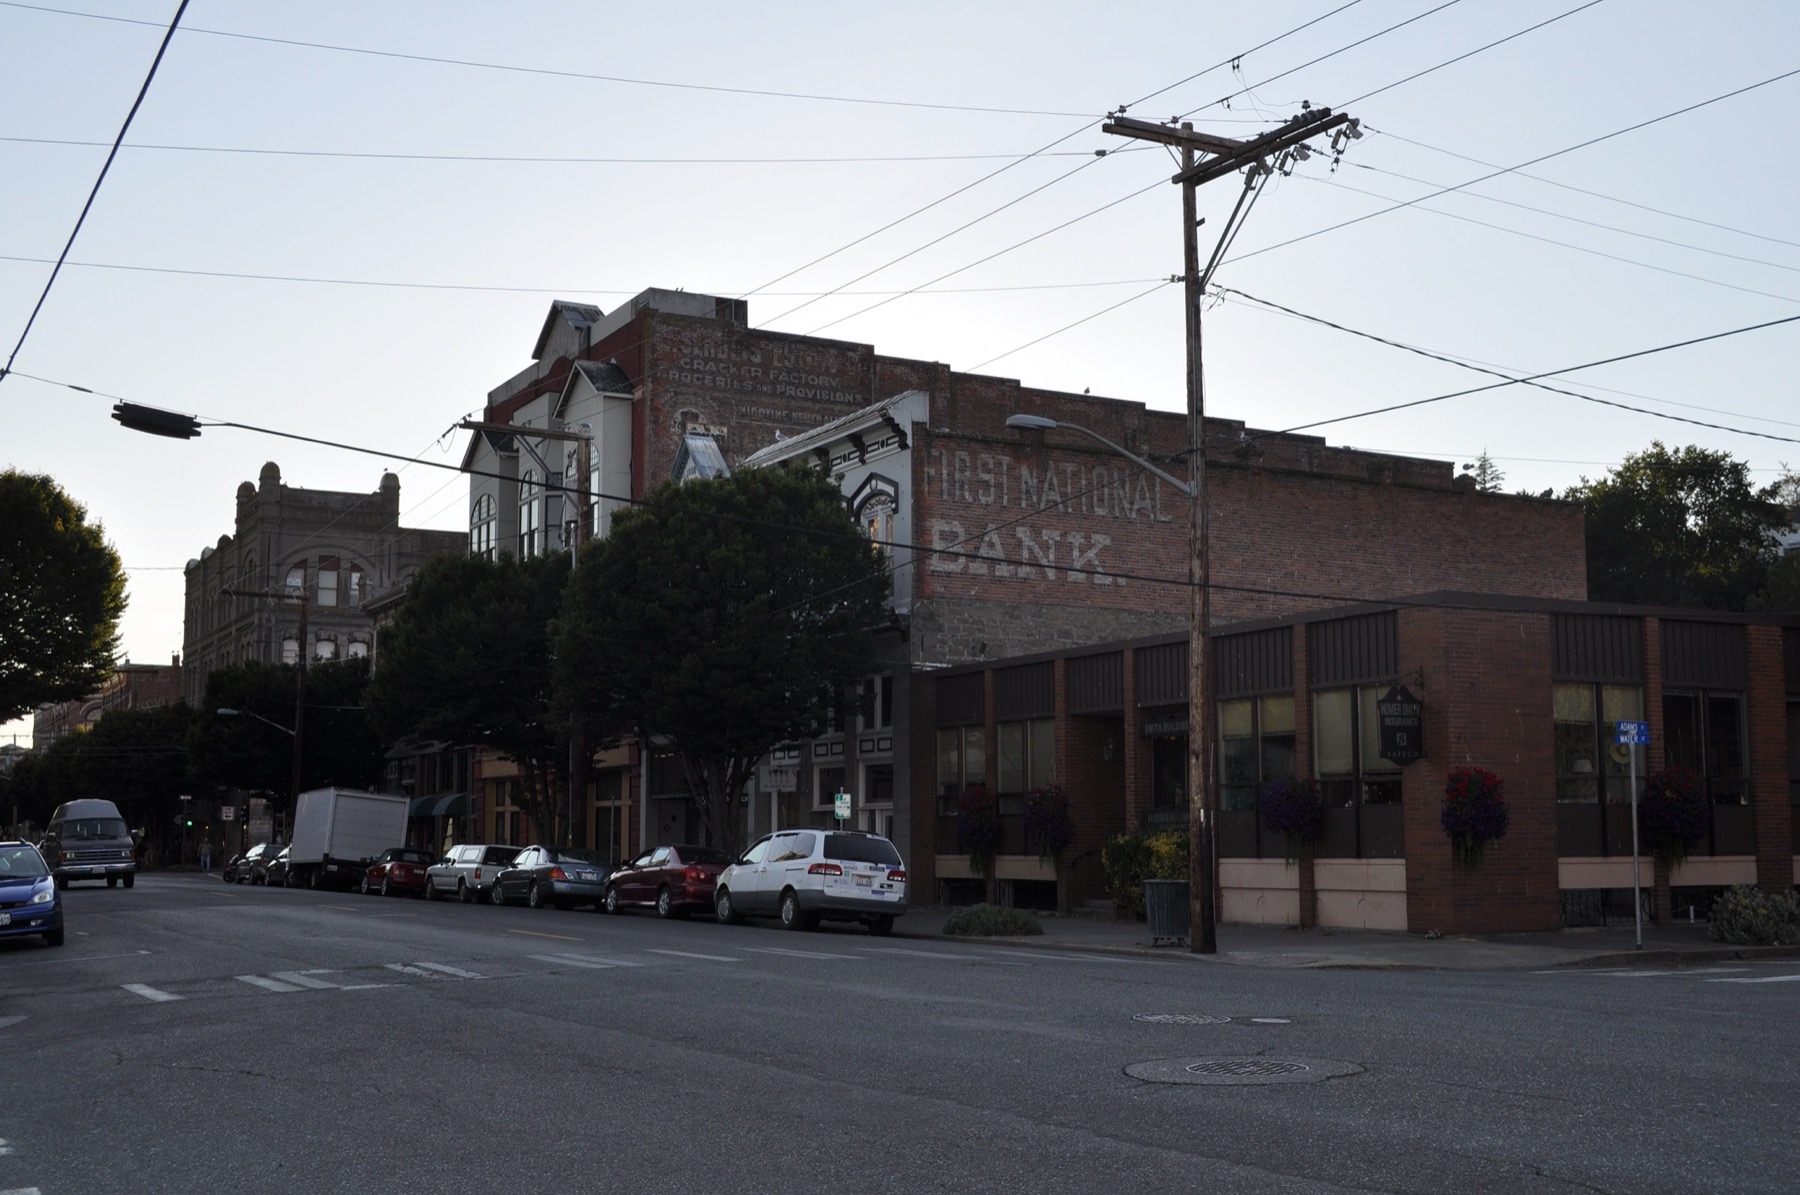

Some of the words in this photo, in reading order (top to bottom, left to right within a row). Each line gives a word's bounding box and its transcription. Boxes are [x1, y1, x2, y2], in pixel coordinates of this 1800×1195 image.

[680, 358, 763, 379] CRACKER
[656, 370, 753, 392] GROCERIES
[756, 383, 773, 394] AND
[776, 382, 865, 404] PROVISIONS
[924, 448, 1010, 506] FIRST
[1020, 460, 1173, 524] NATIONAL
[1380, 703, 1402, 716] HOMER
[1402, 703, 1420, 716] SMITH
[1384, 716, 1419, 726] INSURANCE
[1620, 722, 1638, 732] ADAMS
[1144, 723, 1163, 735] SMITH
[1163, 721, 1189, 734] BUILDING
[1620, 734, 1638, 744] WATER
[1386, 750, 1418, 758] SAFECO
